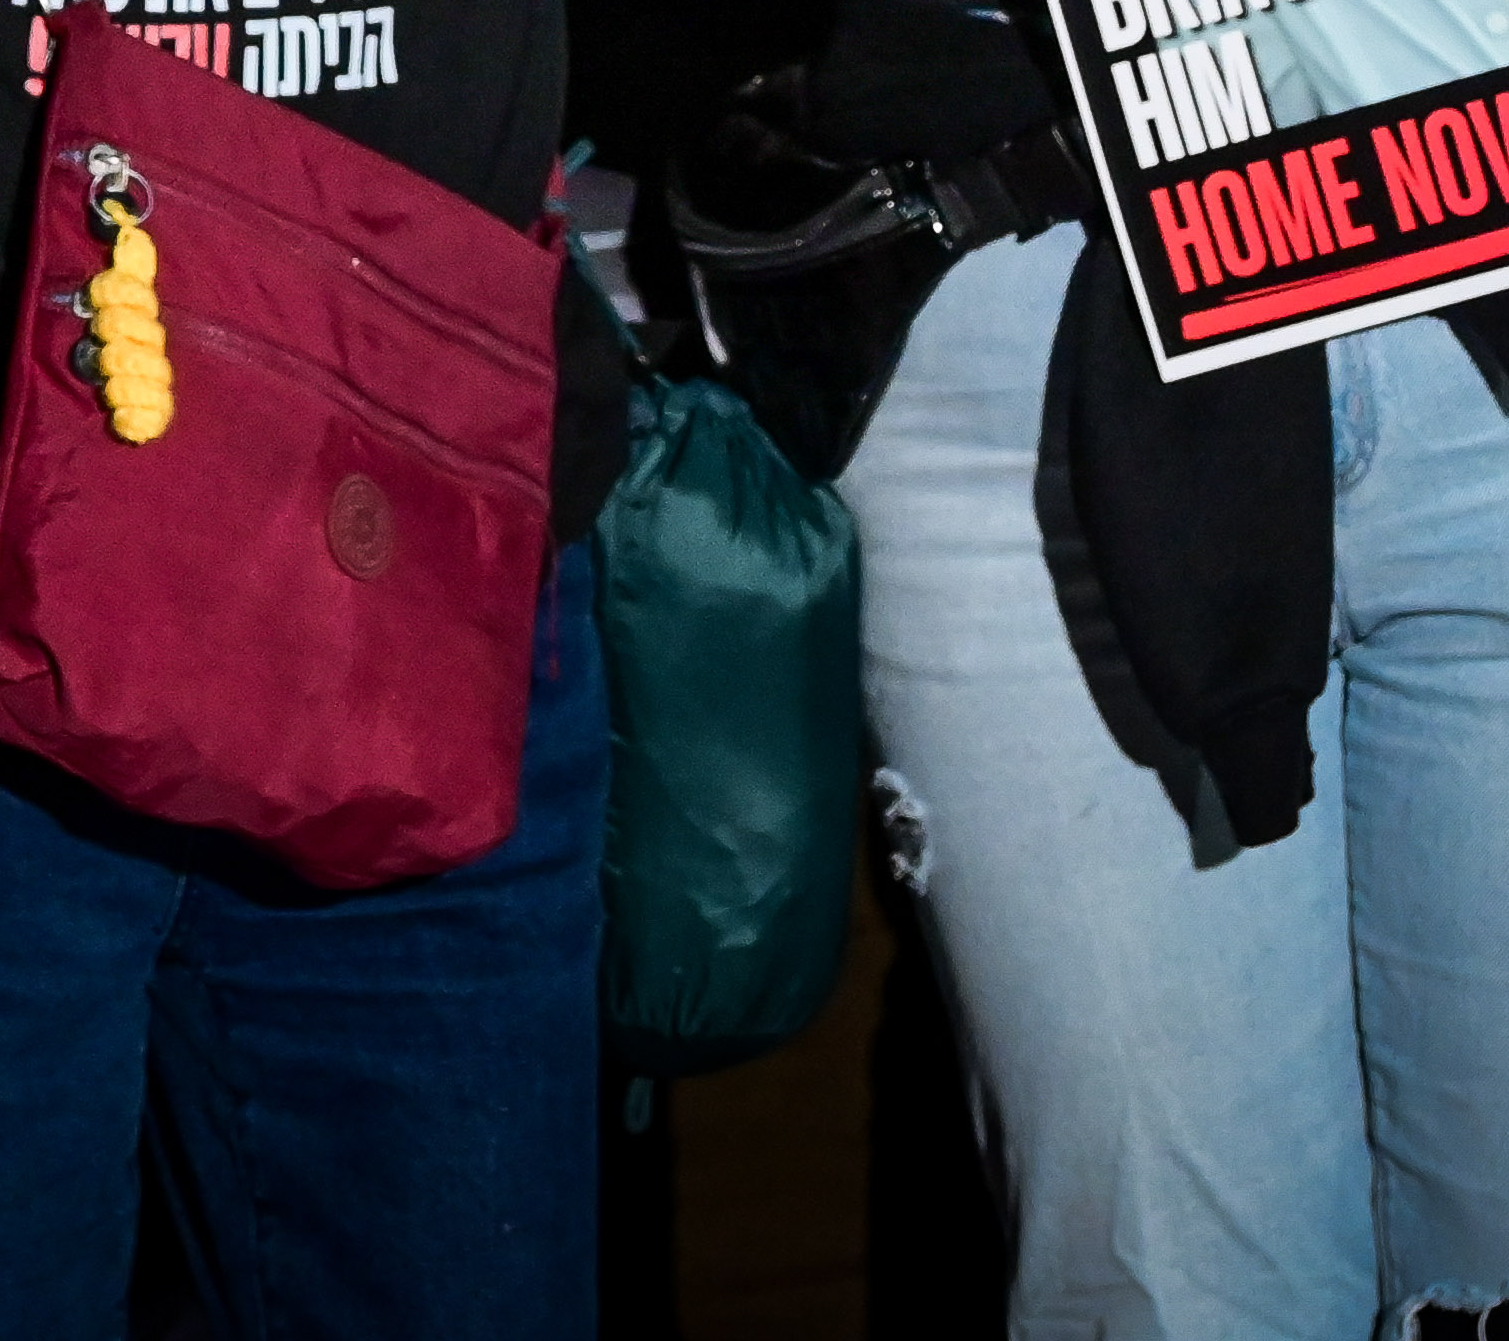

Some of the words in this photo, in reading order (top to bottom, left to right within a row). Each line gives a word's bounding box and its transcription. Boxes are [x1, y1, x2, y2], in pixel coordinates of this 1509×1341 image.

[242, 6, 399, 99] הביתה
[1110, 28, 1272, 170] HIM
[1150, 136, 1377, 294] HOME
